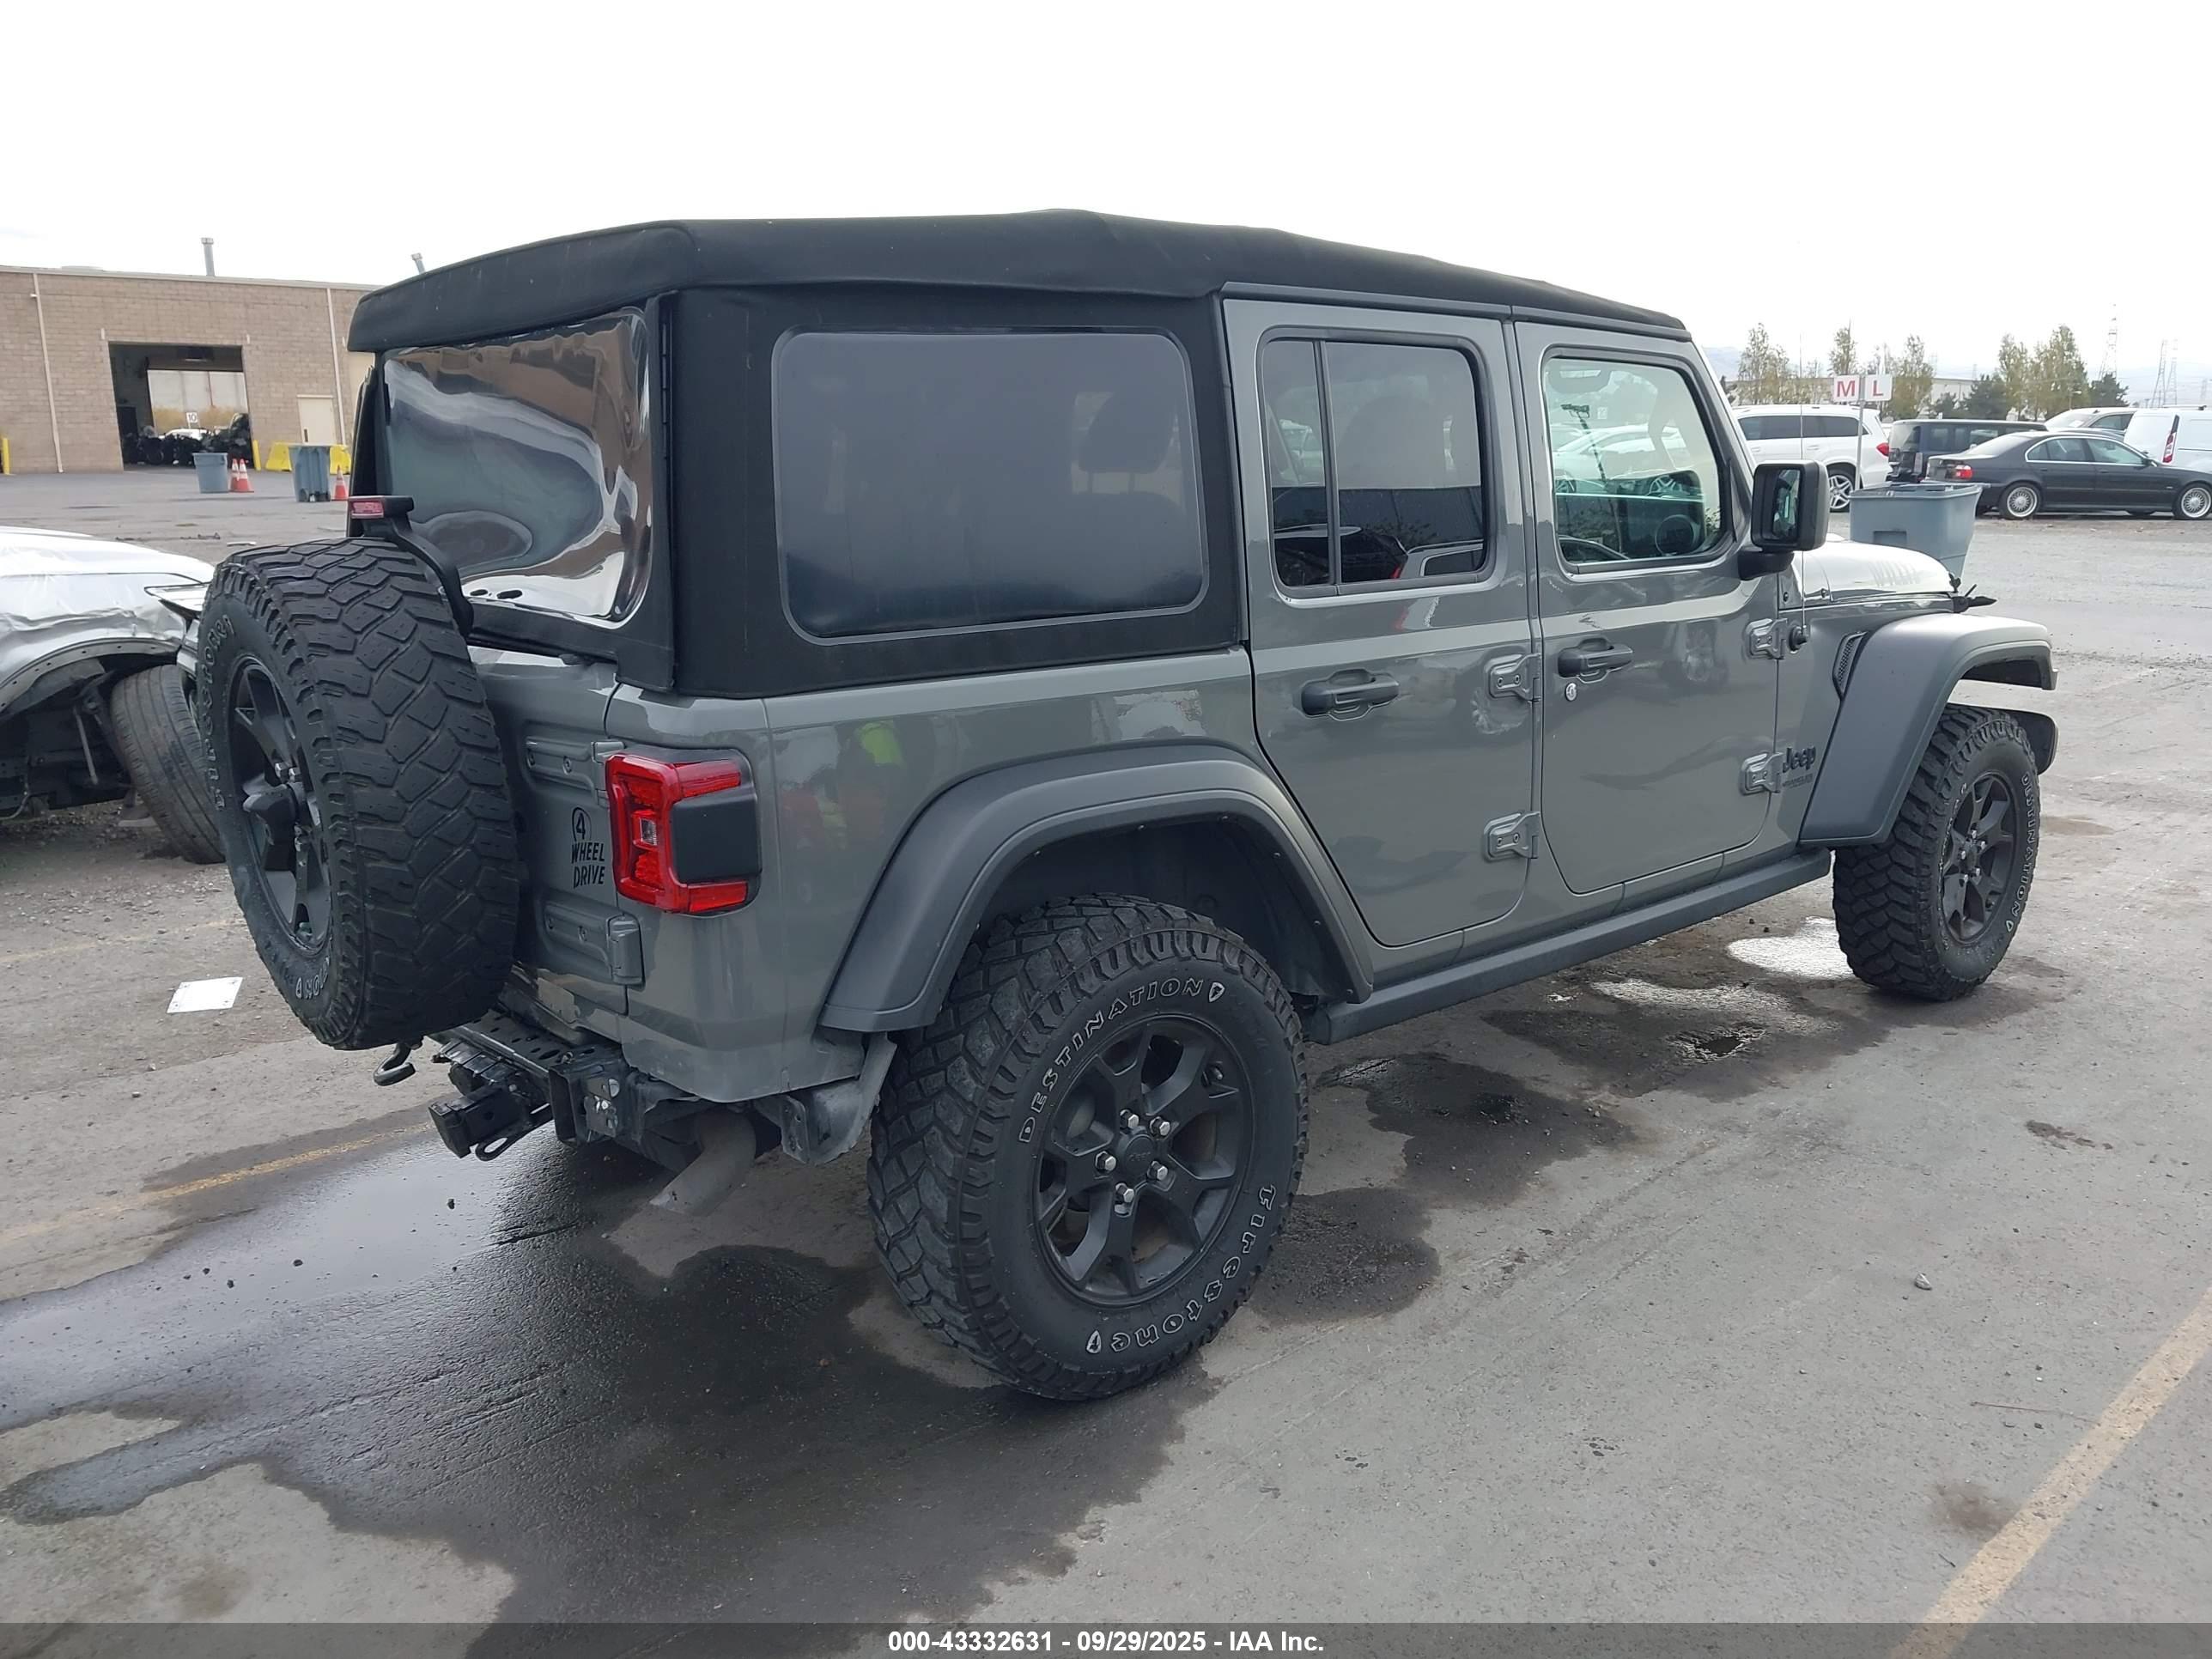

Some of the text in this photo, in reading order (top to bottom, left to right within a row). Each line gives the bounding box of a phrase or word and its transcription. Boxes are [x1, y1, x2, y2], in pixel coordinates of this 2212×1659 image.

[1837, 380, 1856, 397] M
[1873, 380, 1884, 396] L
[1783, 746, 1815, 771] Jeep
[572, 842, 605, 864] WHEEL
[2012, 773, 2036, 916] DESTINATION
[574, 865, 605, 889] DRIVE
[1019, 978, 1203, 1142] DESTINATION
[1111, 1185, 1276, 1352] Firestone
